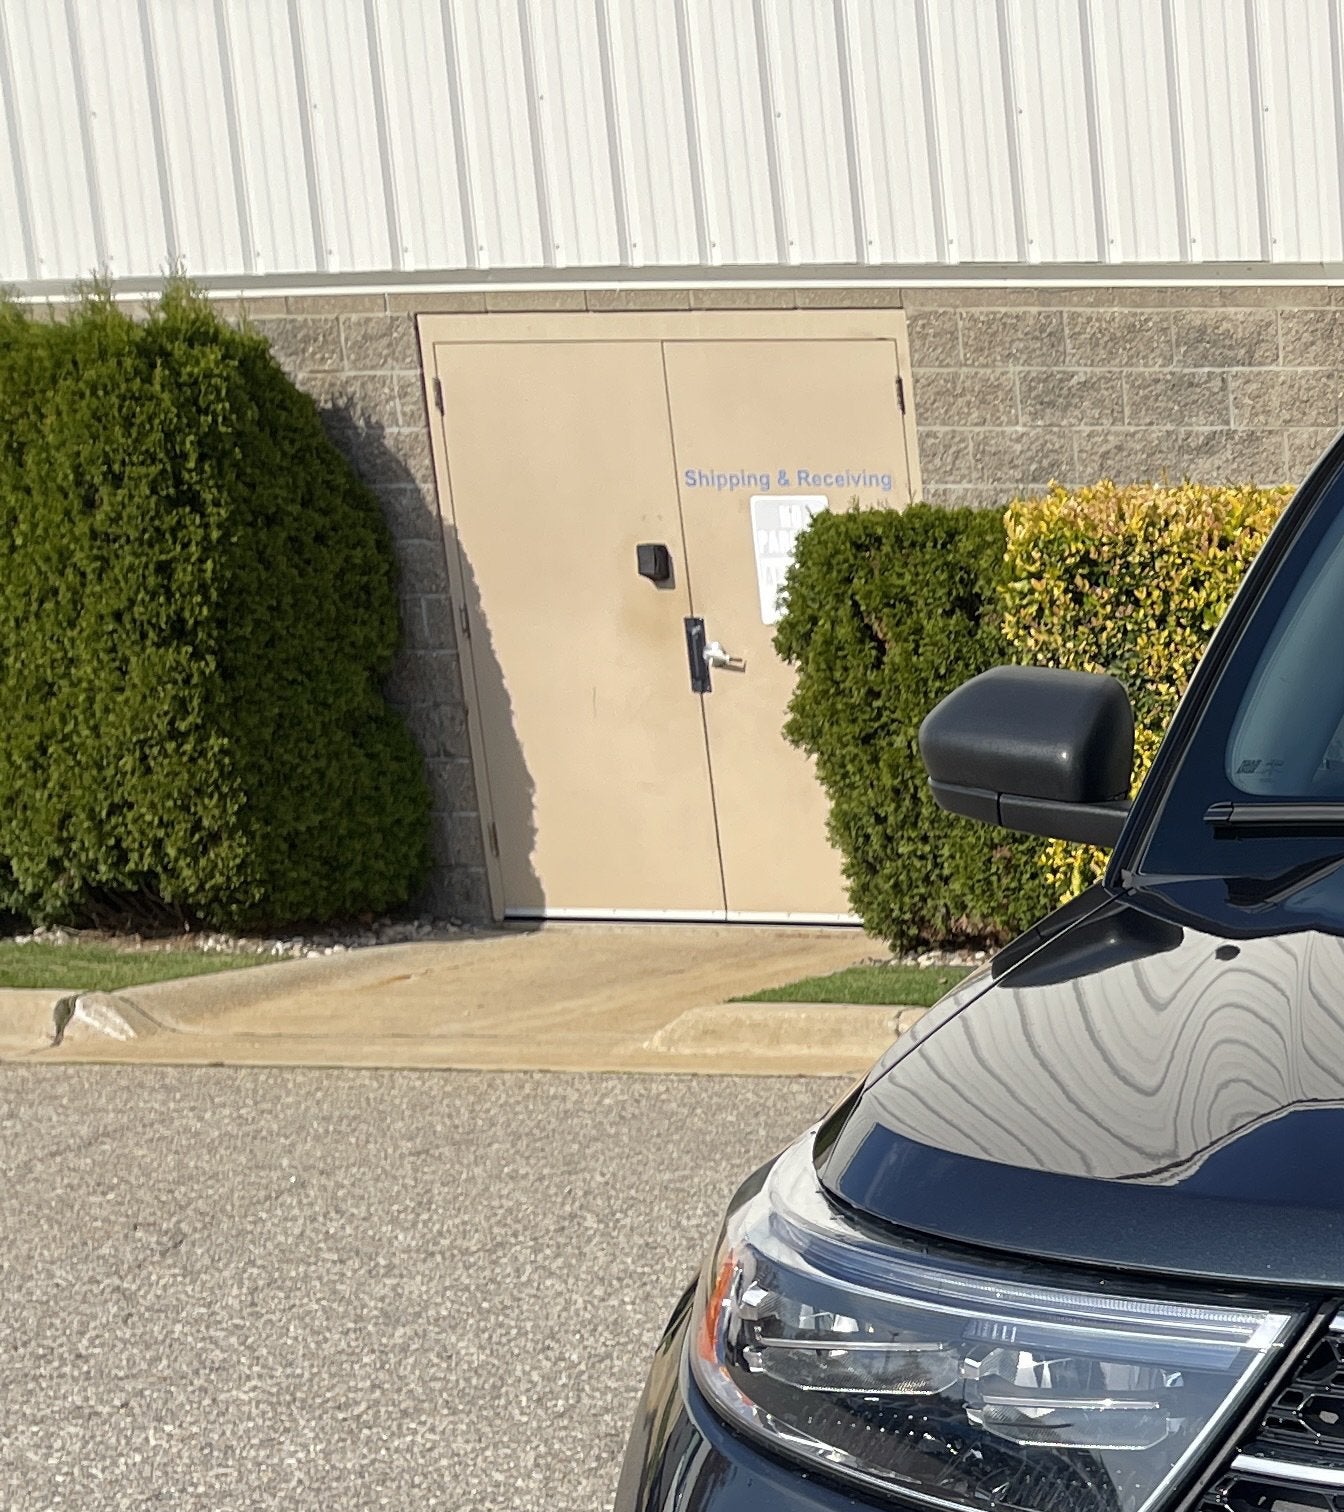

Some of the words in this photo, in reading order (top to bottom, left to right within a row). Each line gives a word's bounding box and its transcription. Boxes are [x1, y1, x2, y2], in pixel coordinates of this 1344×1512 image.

[684, 468, 770, 492] Shipping
[777, 469, 790, 487] &
[797, 469, 893, 491] Receiving
